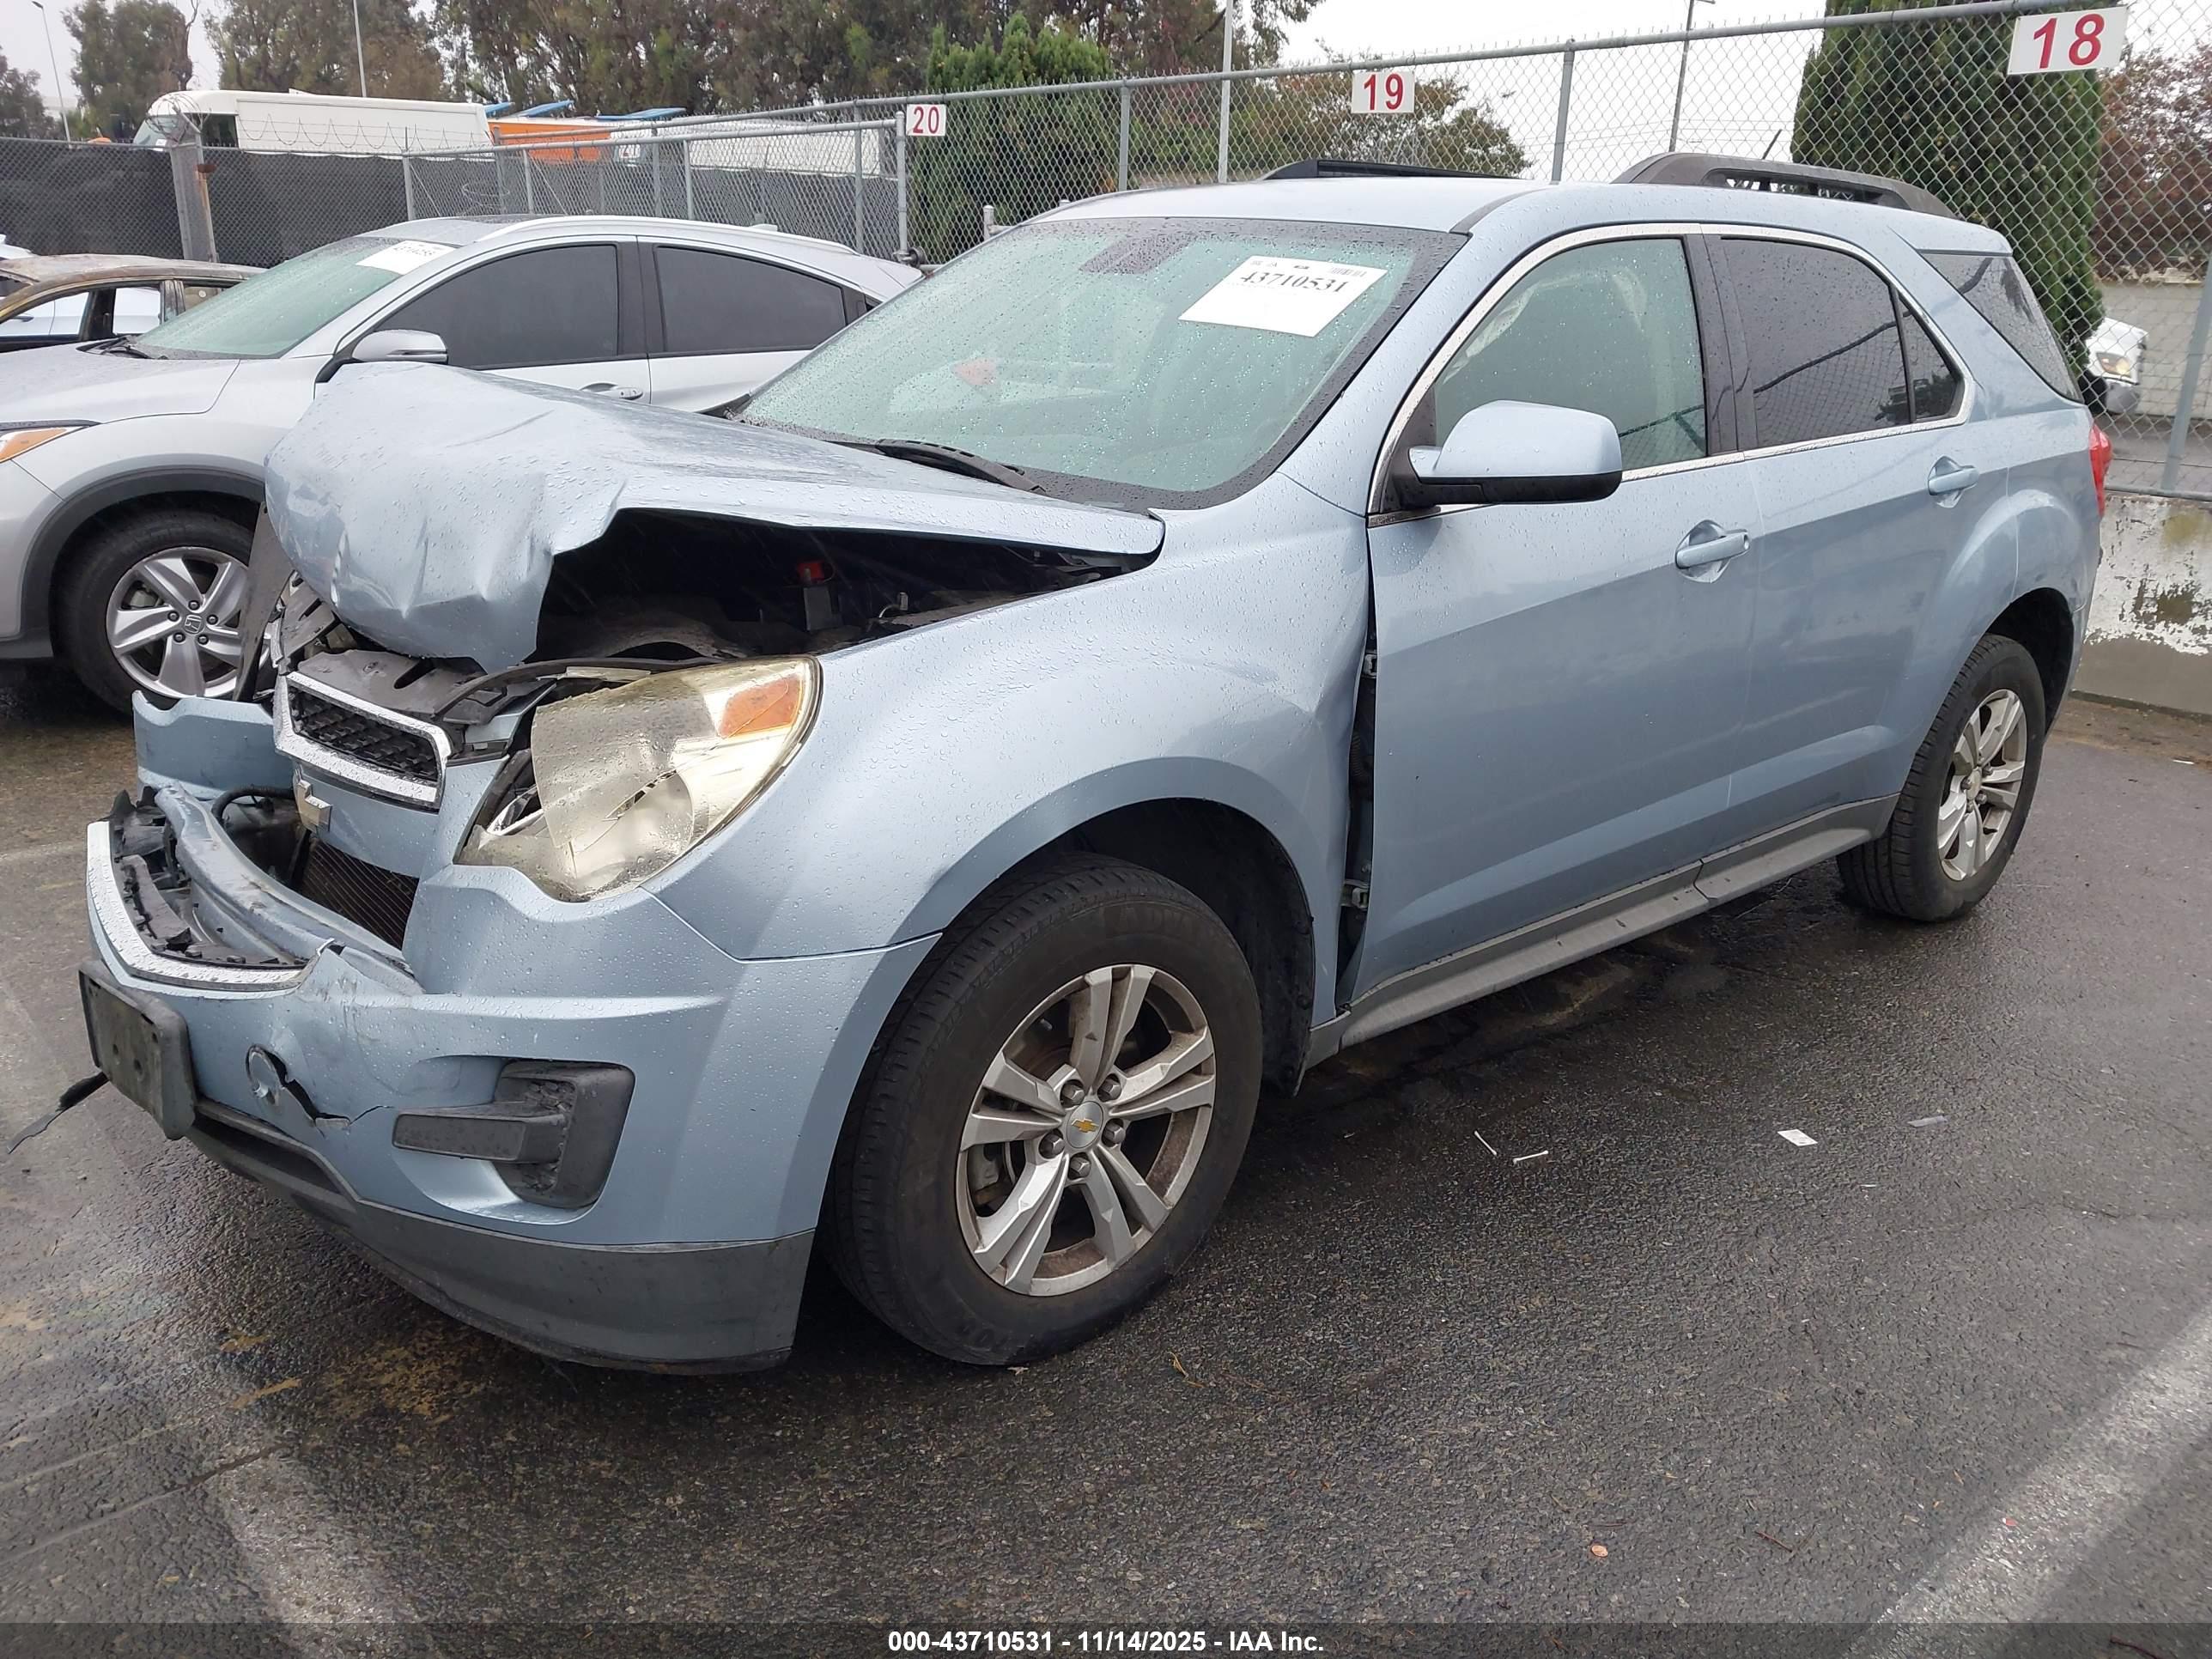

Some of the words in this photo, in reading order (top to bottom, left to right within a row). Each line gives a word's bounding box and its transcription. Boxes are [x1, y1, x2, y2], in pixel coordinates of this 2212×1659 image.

[2033, 13, 2105, 69] 18
[1364, 73, 1403, 111] 19
[913, 106, 939, 134] 20
[1240, 270, 1349, 293] 43710531
